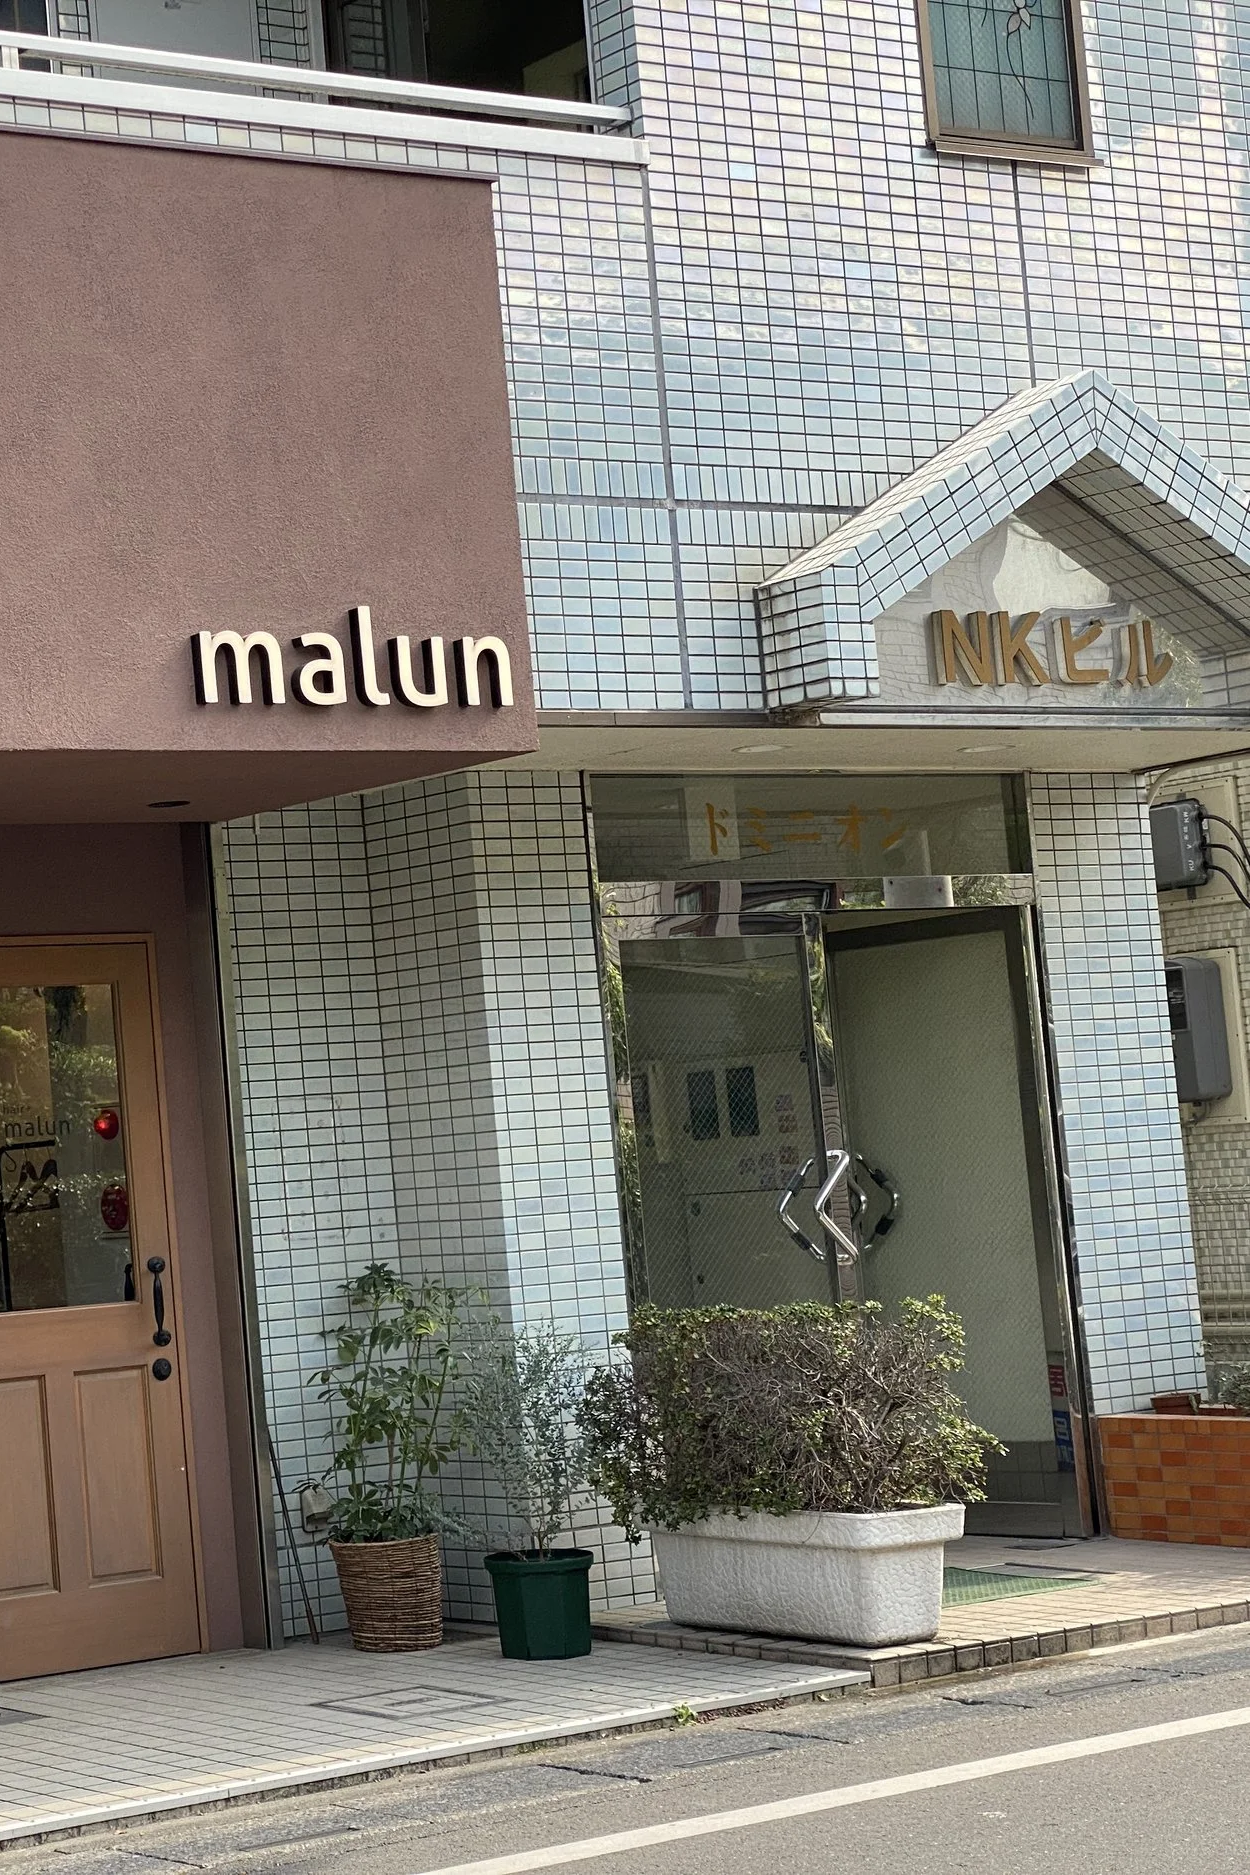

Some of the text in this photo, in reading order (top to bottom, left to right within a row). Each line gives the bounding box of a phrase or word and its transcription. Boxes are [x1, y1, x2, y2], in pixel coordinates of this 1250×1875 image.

[190, 605, 515, 708] malun
[706, 802, 908, 857] ドミニオン
[4, 1116, 70, 1138] malun
